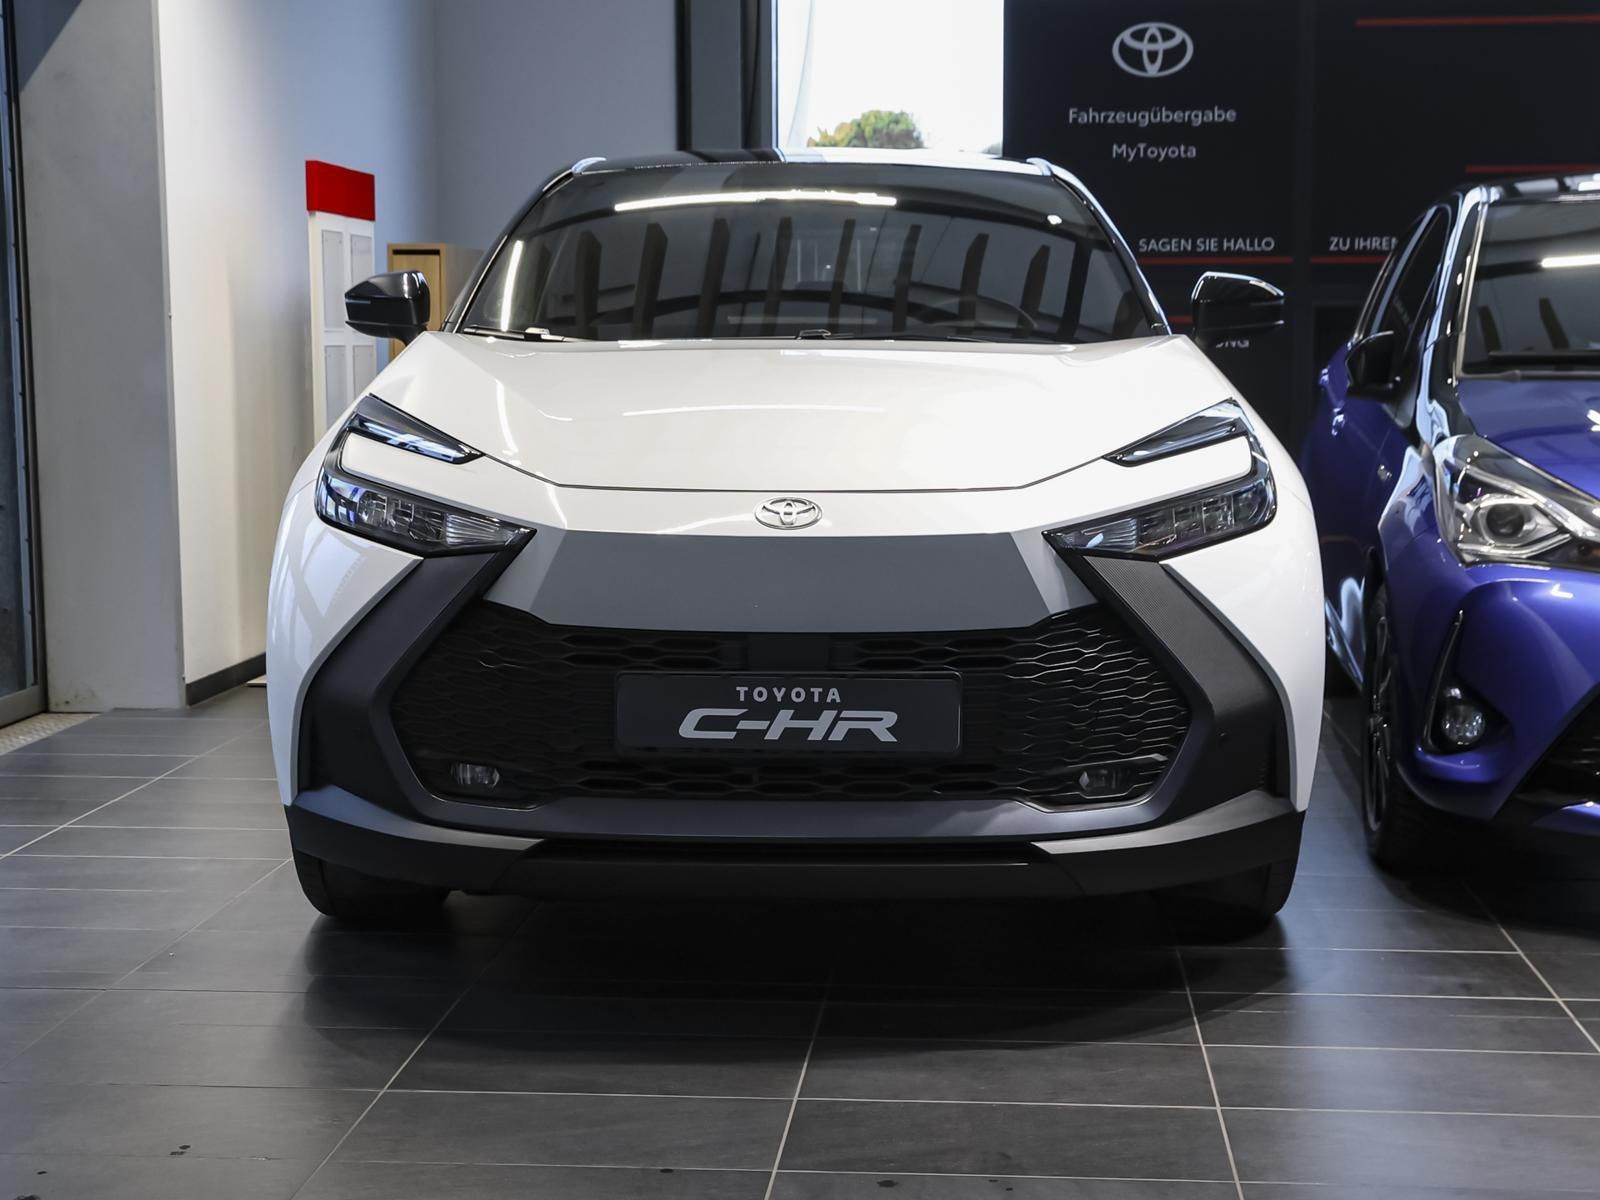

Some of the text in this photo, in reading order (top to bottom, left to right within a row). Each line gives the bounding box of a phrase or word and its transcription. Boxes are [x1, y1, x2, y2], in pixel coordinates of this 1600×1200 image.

[1068, 106, 1237, 127] Fahrzeugübergabe
[1111, 143, 1197, 162] MyToyota
[1138, 236, 1276, 252] SAGEN SIE HALLO
[1329, 236, 1351, 251] ZU
[736, 686, 842, 704] TOYOTA
[678, 708, 899, 743] C-HR
